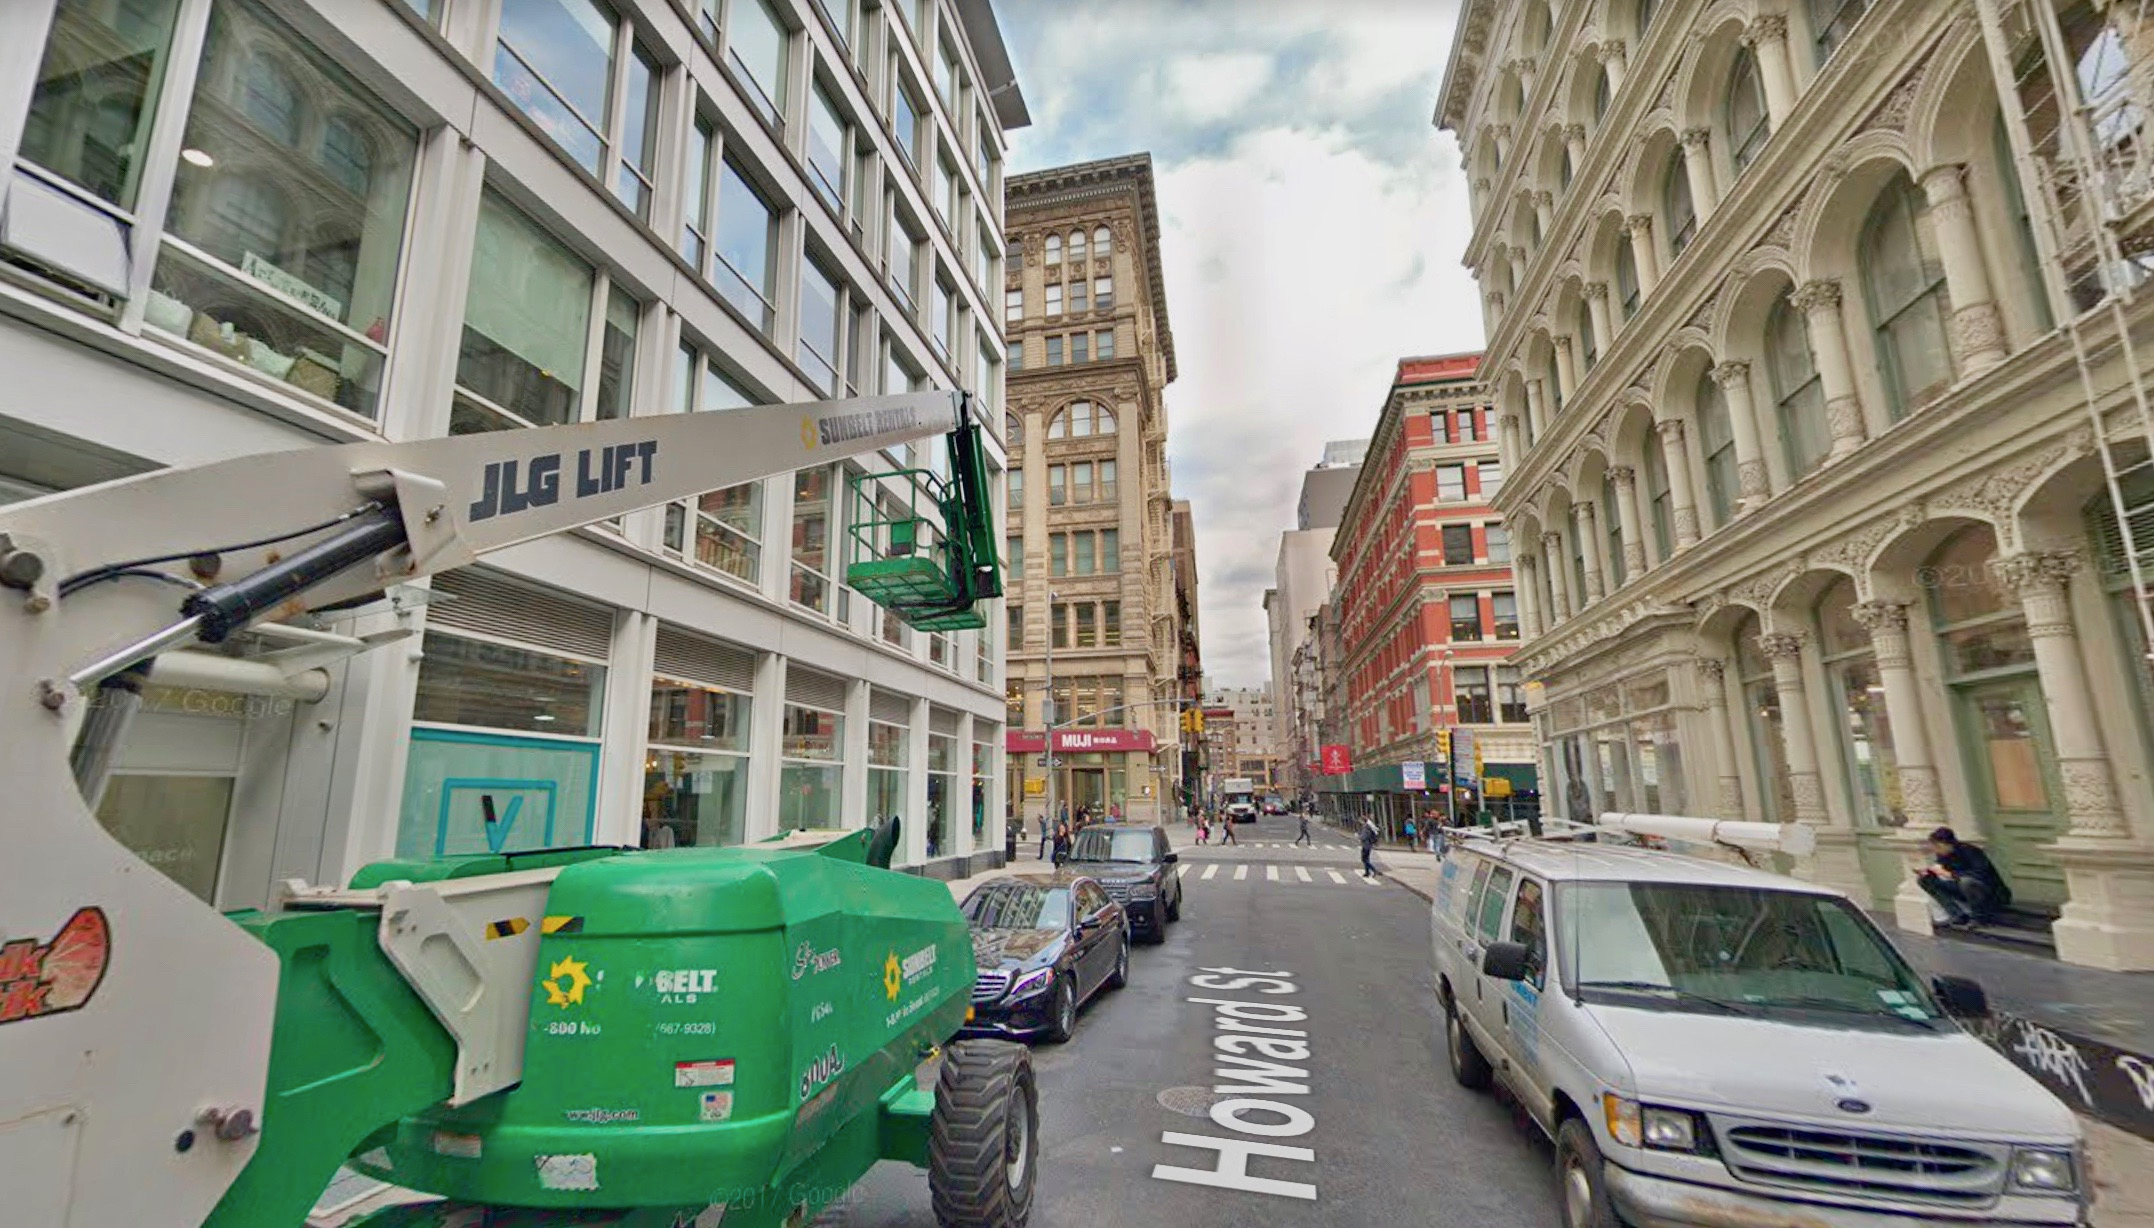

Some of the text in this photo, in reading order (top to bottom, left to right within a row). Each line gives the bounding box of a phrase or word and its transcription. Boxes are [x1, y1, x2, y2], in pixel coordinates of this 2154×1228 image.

[469, 440, 658, 523] JLG LIFT
[1062, 734, 1092, 748] MUJI
